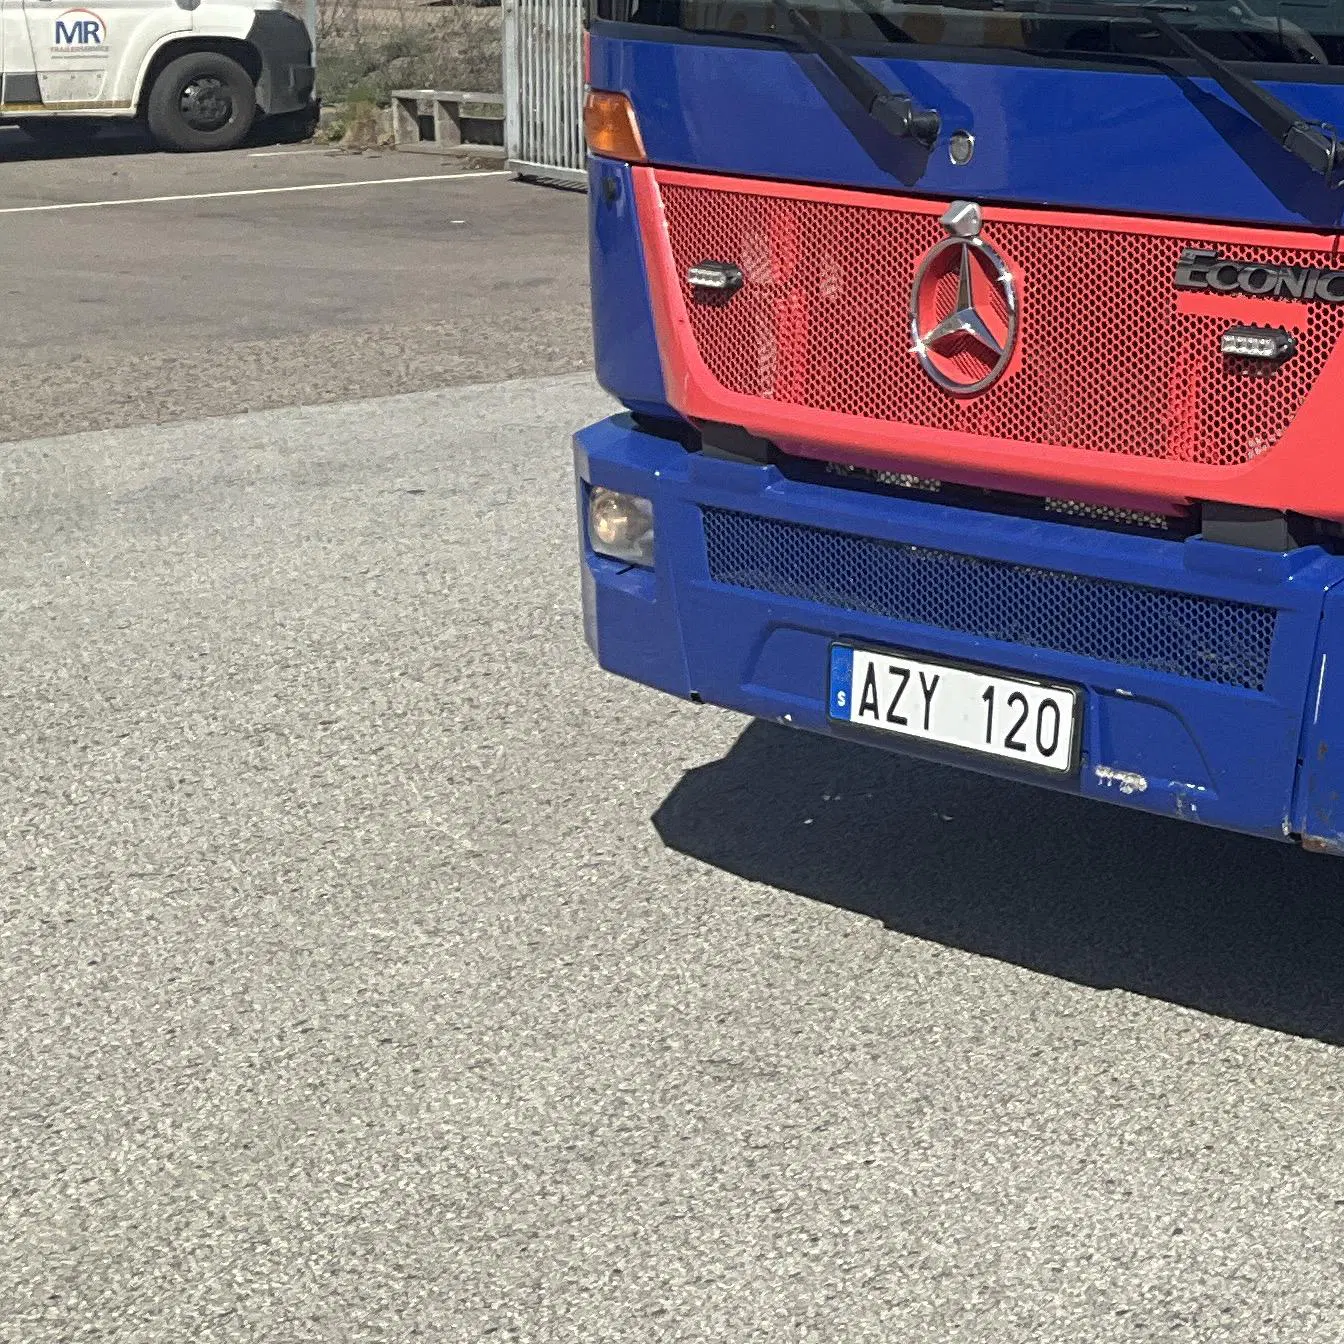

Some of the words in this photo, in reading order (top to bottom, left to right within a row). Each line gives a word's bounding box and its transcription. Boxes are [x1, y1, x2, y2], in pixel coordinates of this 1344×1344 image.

[55, 21, 101, 44] MR
[837, 690, 846, 707] S
[858, 661, 940, 731] AZY
[982, 685, 1061, 757] 120
